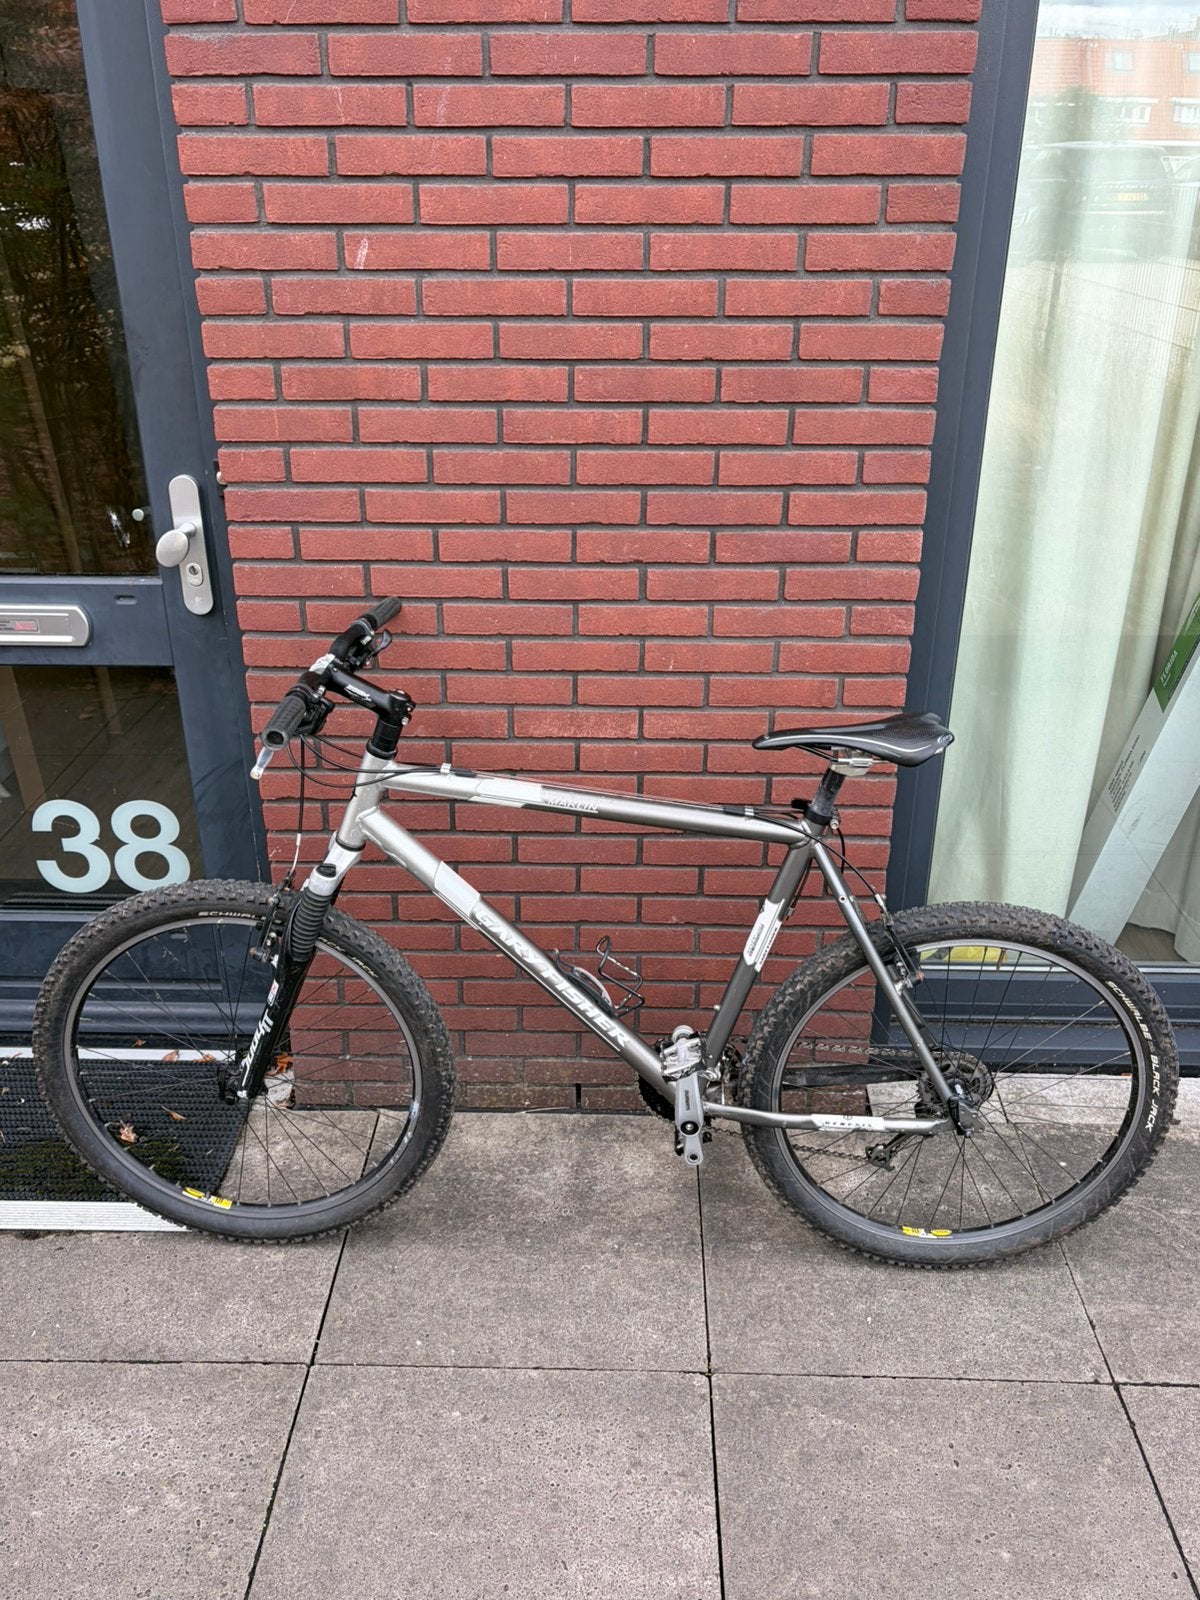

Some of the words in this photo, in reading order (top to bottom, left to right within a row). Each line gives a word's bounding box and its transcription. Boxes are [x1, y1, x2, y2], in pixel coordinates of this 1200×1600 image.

[32, 799, 191, 893] 38
[474, 907, 546, 964] GARY
[540, 964, 632, 1049] FISHER
[1105, 980, 1153, 1040] SCHWALBE
[1151, 1054, 1160, 1097] BLACK
[1145, 1099, 1159, 1133] JACK
